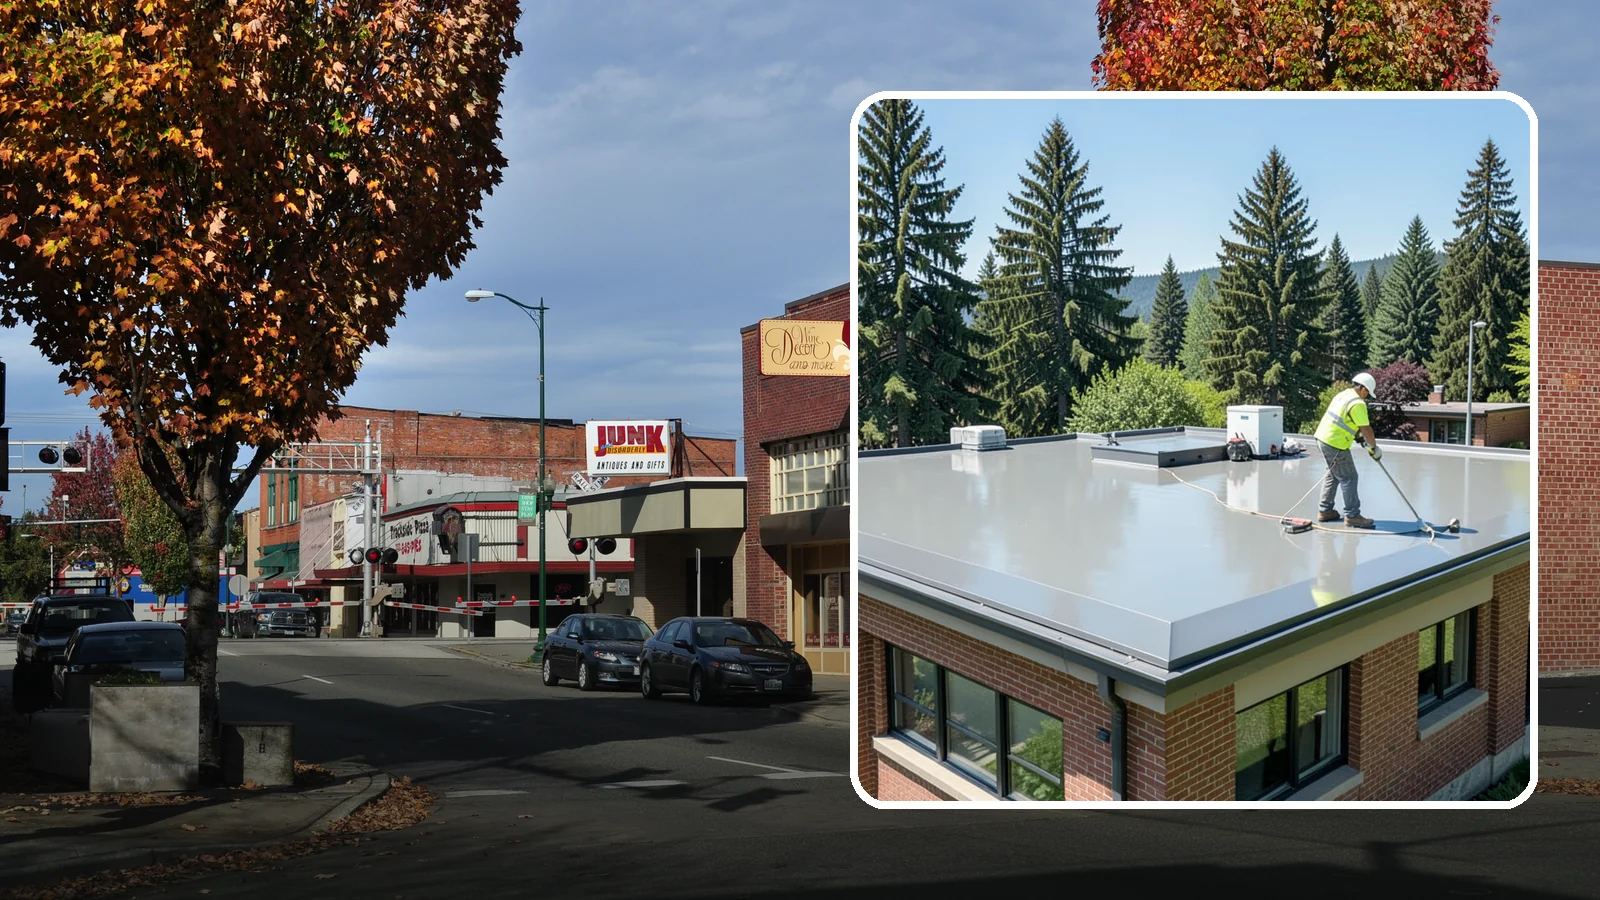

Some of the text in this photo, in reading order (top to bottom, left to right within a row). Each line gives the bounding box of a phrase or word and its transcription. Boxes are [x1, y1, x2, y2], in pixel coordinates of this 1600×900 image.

[596, 425, 665, 457] JUNK
[607, 446, 646, 454] DISORDERLY
[597, 460, 666, 470] ANTIQUES AND GIFTS
[390, 519, 429, 540] Trackside Pizza
